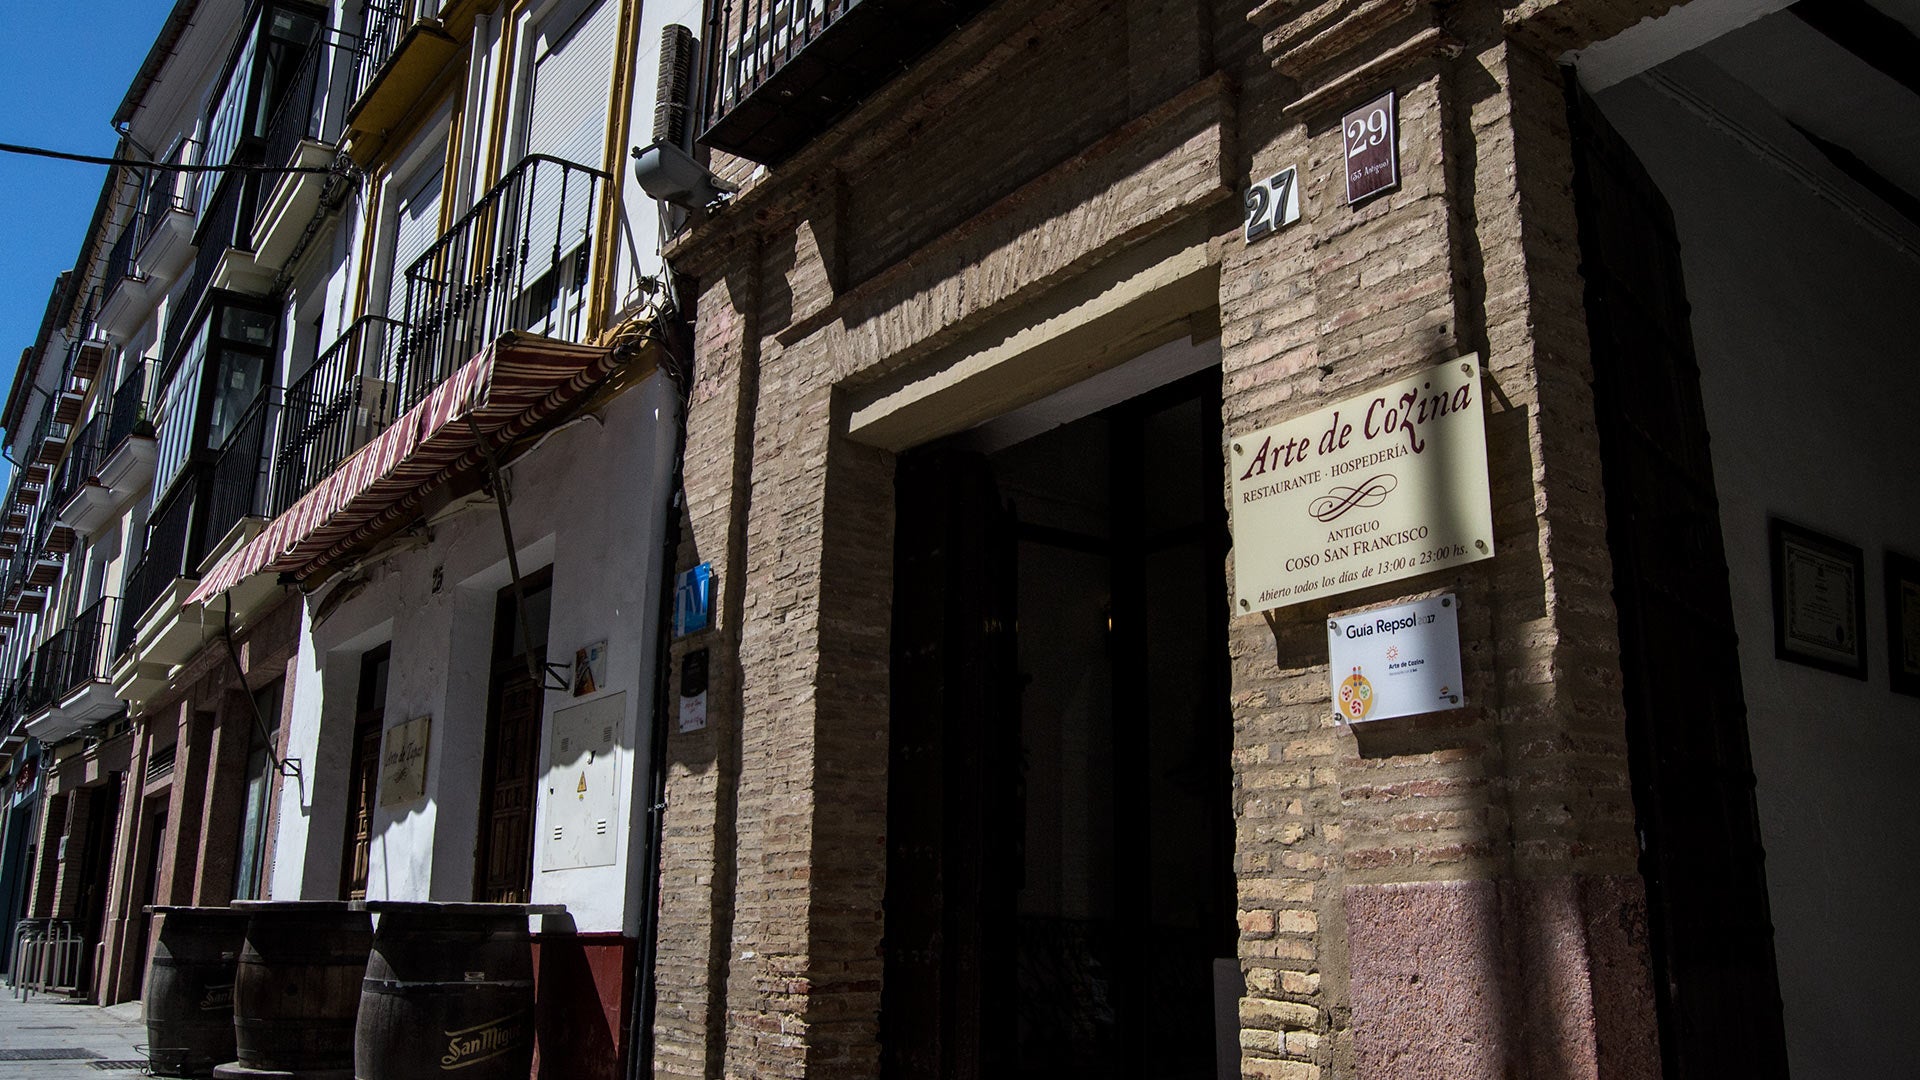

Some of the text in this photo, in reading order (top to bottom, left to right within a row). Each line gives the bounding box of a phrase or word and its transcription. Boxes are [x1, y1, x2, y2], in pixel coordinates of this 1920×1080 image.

[1347, 109, 1388, 159] 29
[1246, 168, 1296, 240] 27
[1240, 436, 1310, 481] Arte
[1318, 411, 1352, 456] de
[1243, 443, 1409, 503] RESTAURANTE HOSPEDERÍA
[1285, 525, 1429, 572] COSO SAN FRANCISCO
[1327, 520, 1380, 543] ANTIGUO
[1258, 544, 1468, 603] Abierto todos los días de 13:00 a 23:00 hs.
[1346, 624, 1373, 639] Guía
[1376, 612, 1416, 635] Repsol
